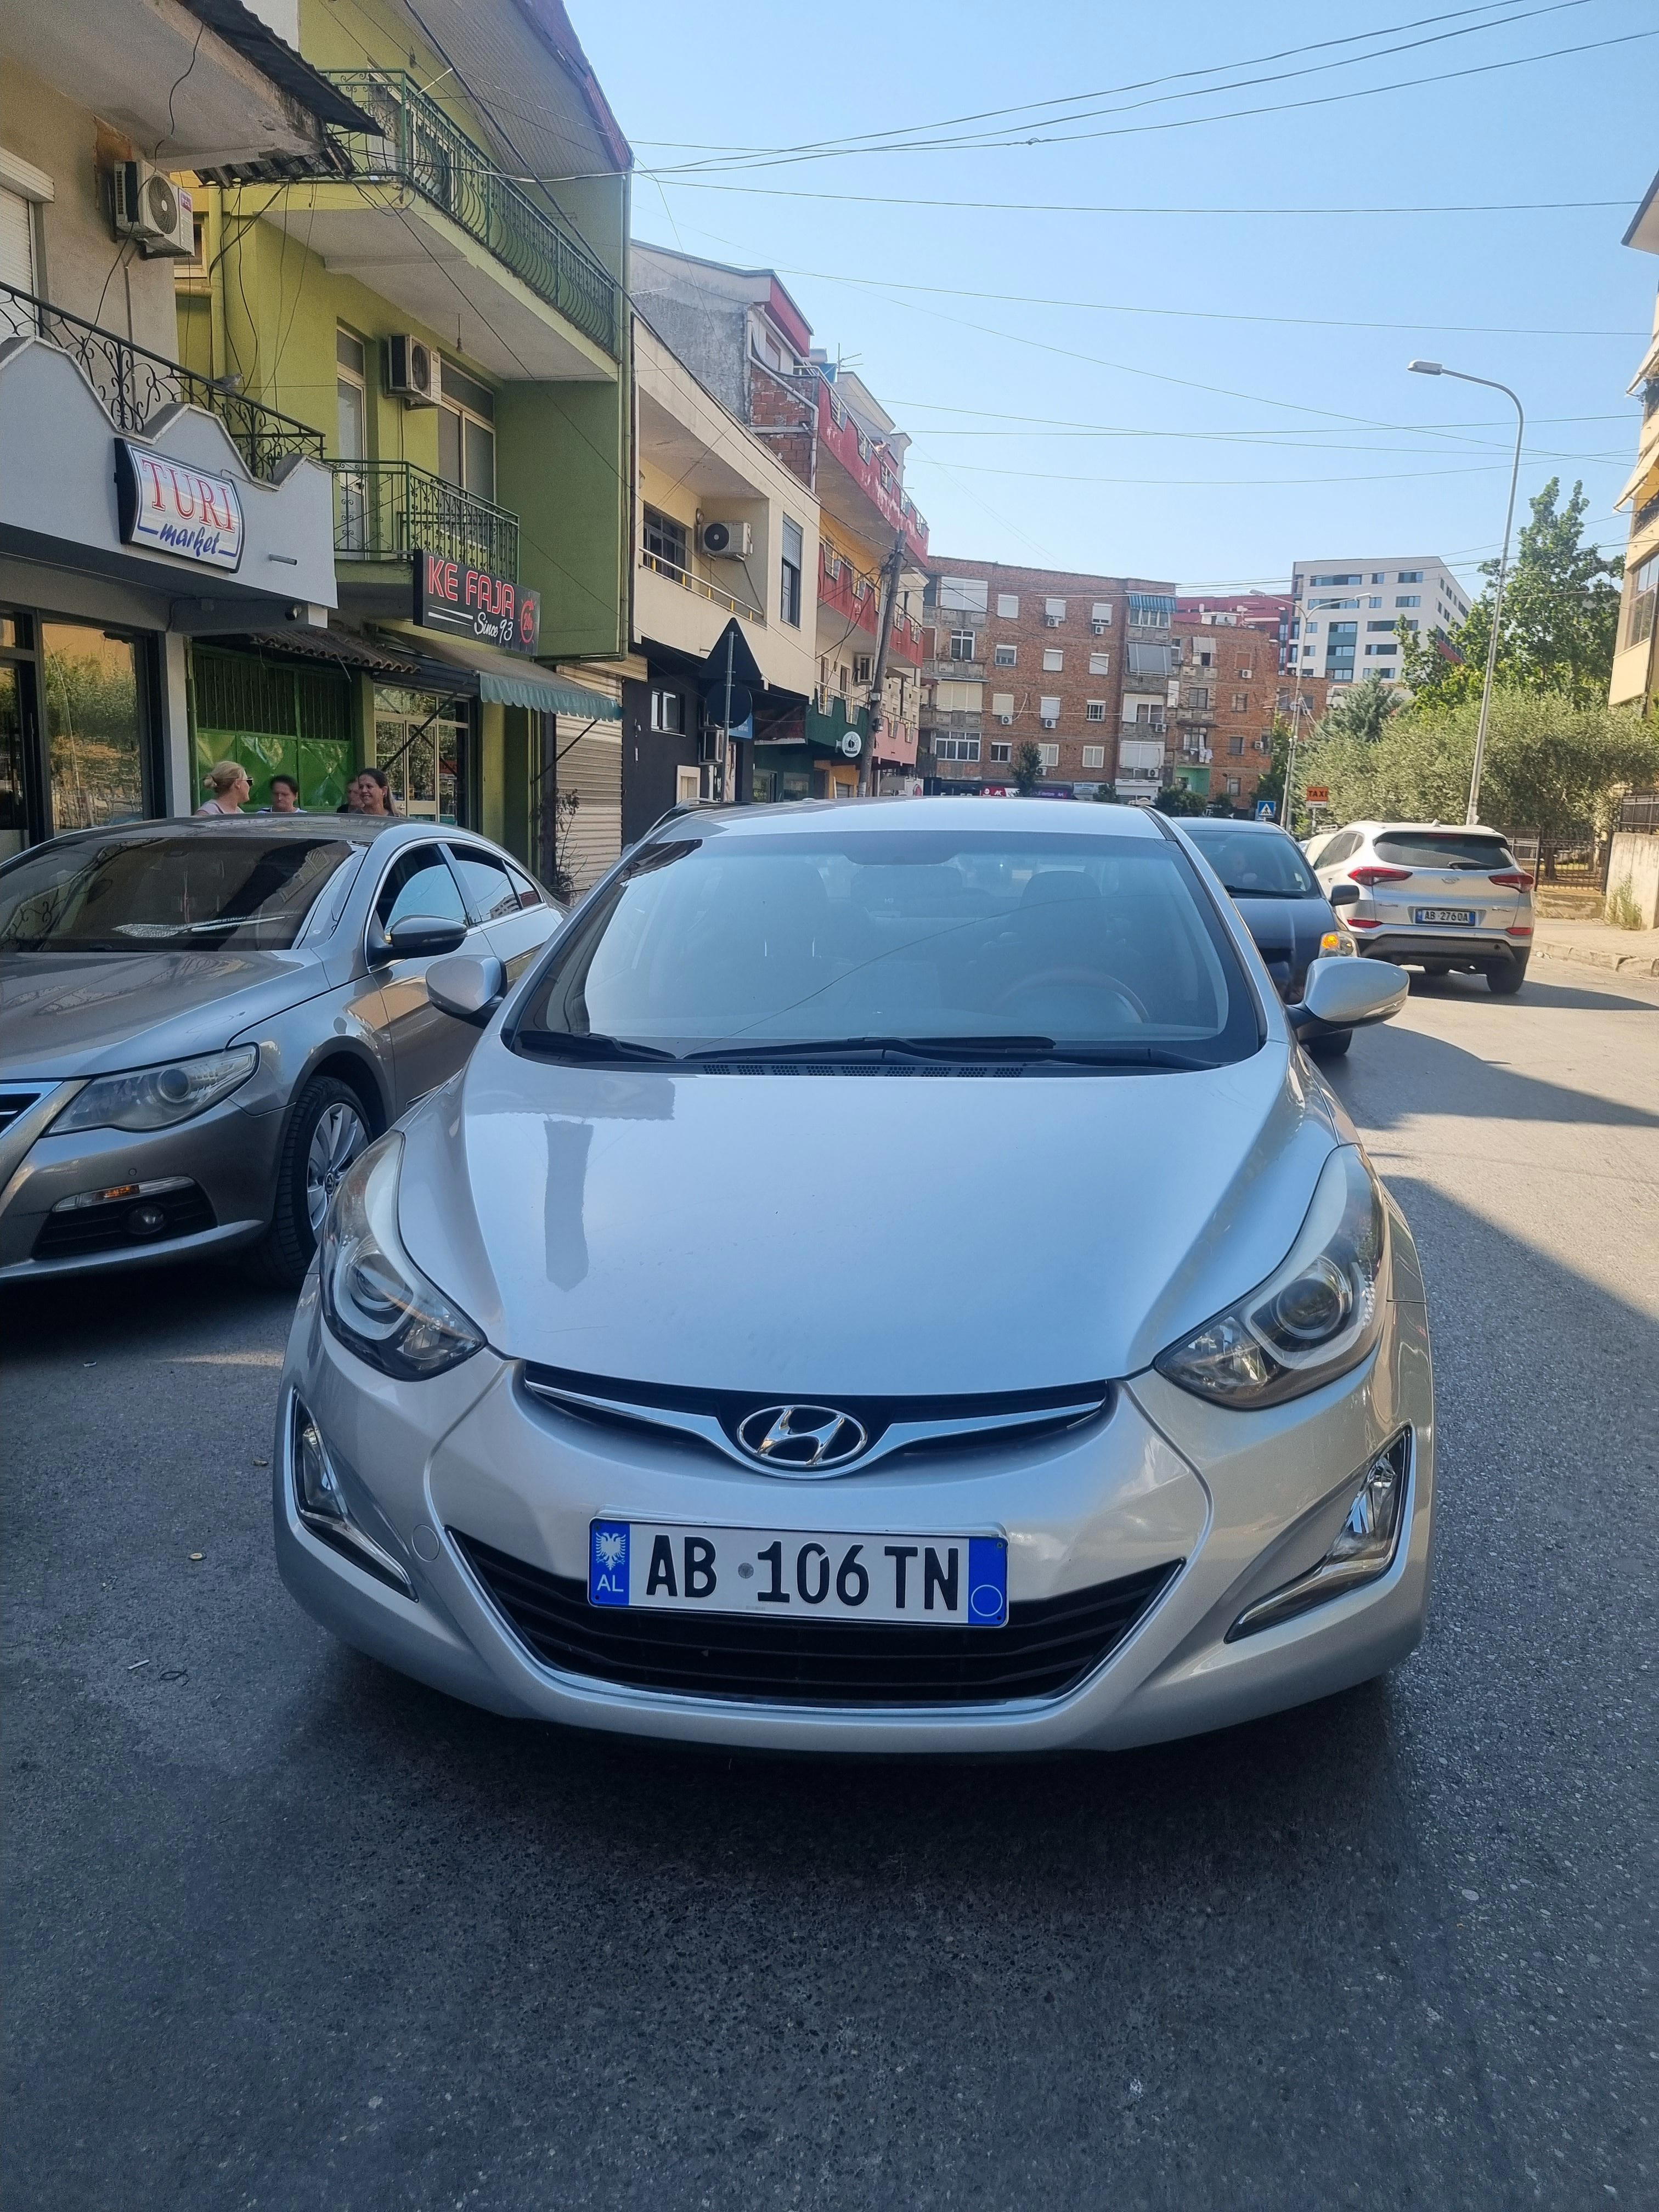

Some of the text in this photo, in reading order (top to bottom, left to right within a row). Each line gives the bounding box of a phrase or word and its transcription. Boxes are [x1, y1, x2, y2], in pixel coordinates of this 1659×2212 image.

[140, 456, 235, 533] TURI
[160, 523, 220, 557] market
[428, 555, 515, 619] KE FAJA
[474, 611, 514, 644] Since 93
[1424, 911, 1435, 920] AB
[596, 1573, 624, 1592] AL
[646, 1534, 960, 1611] AB 106 TN
